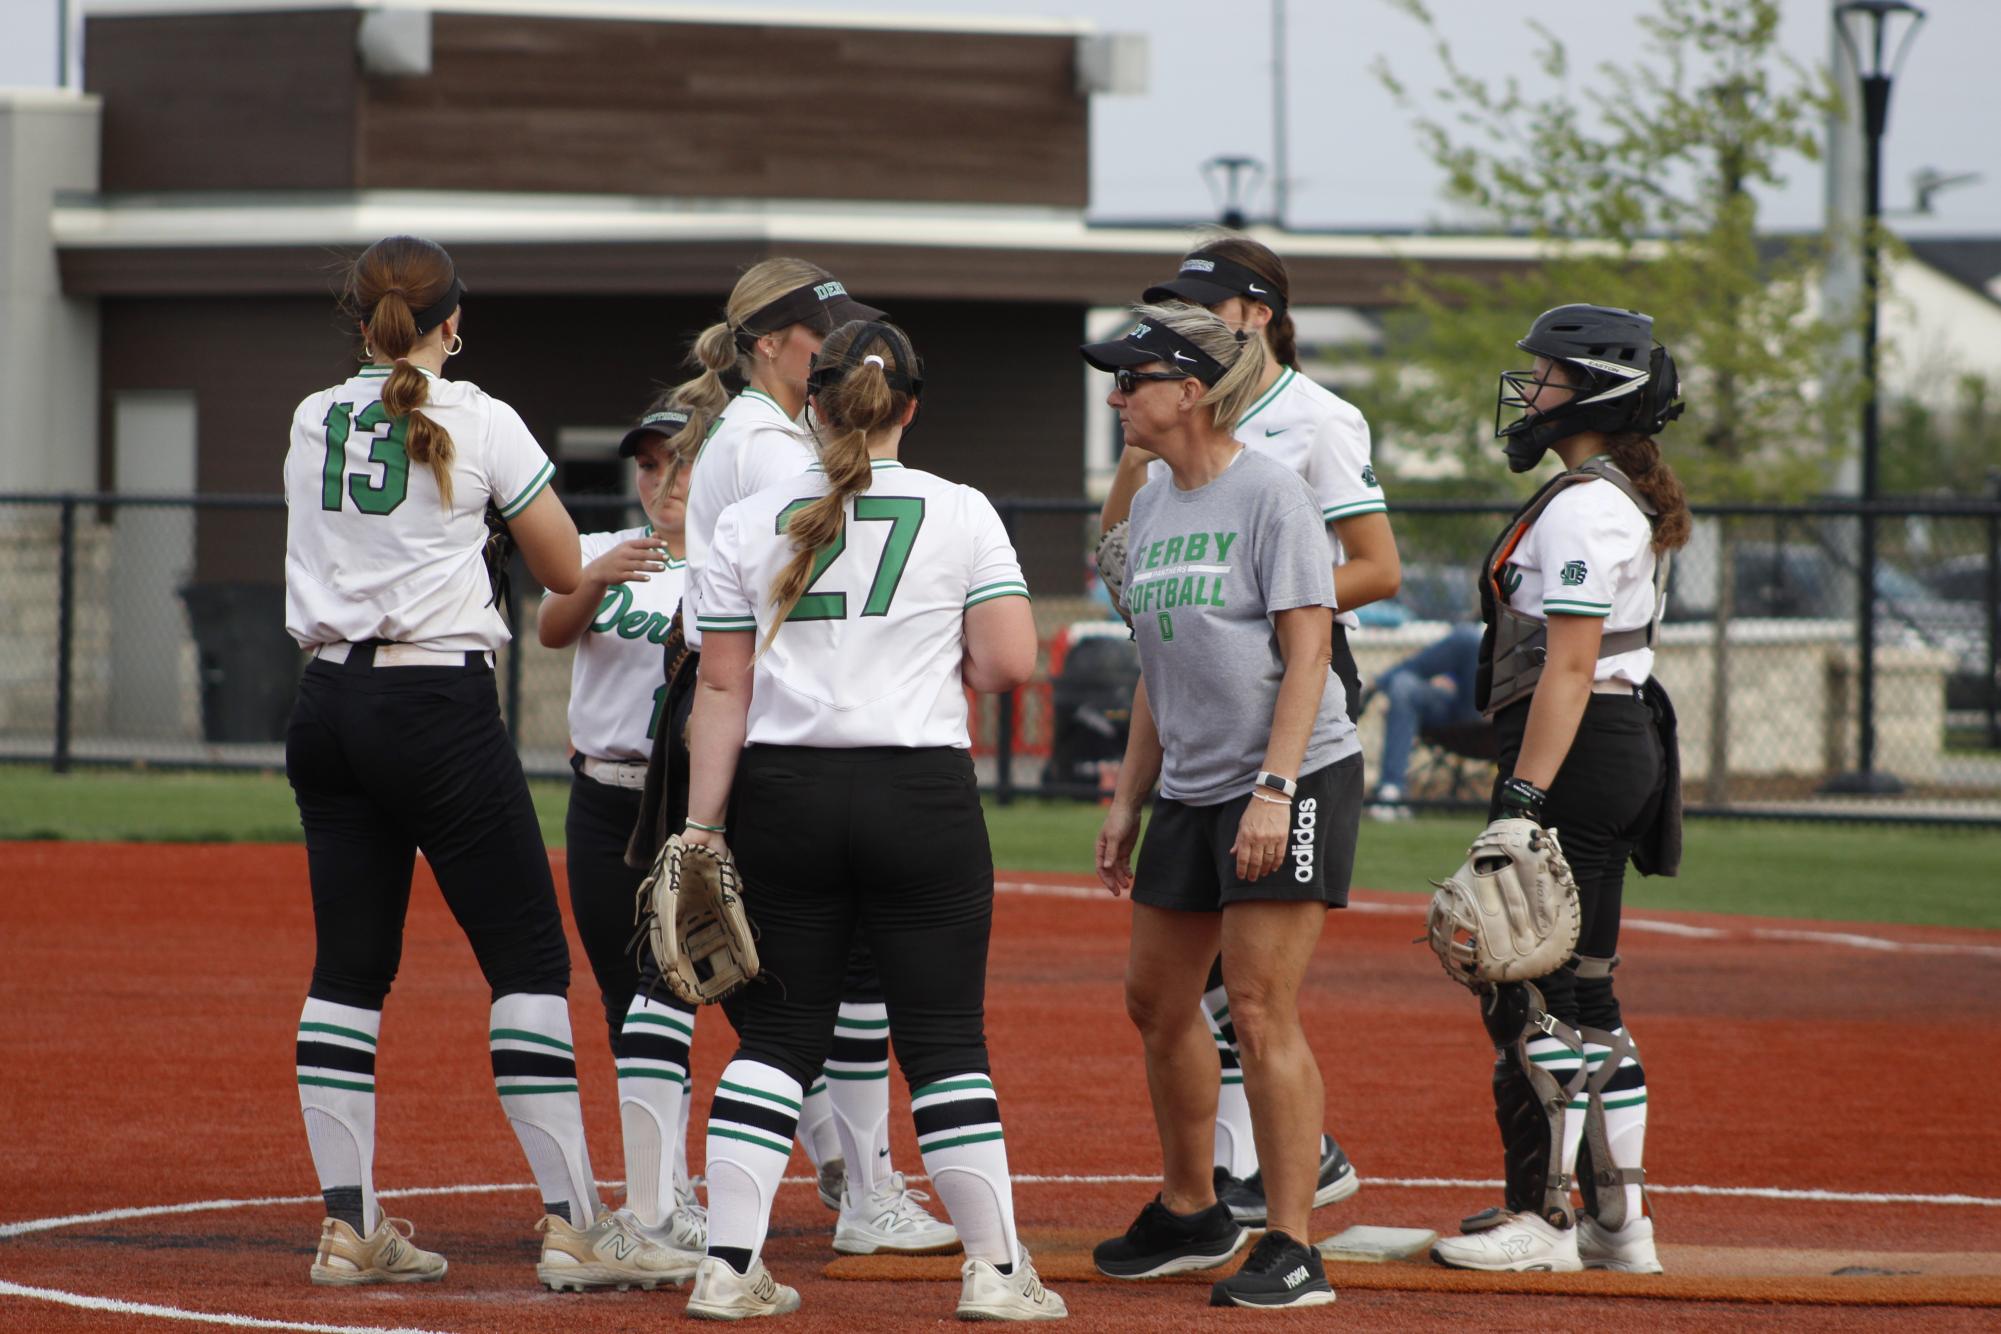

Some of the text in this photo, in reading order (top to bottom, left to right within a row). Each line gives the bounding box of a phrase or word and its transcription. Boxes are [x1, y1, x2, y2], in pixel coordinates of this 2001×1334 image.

[813, 281, 848, 300] DER
[1588, 360, 1620, 373] EASTON
[321, 399, 410, 516] 13
[774, 495, 926, 622] 27
[590, 584, 671, 644] Der
[1291, 797, 1317, 883] adidas
[1282, 1264, 1311, 1289] HOKA
